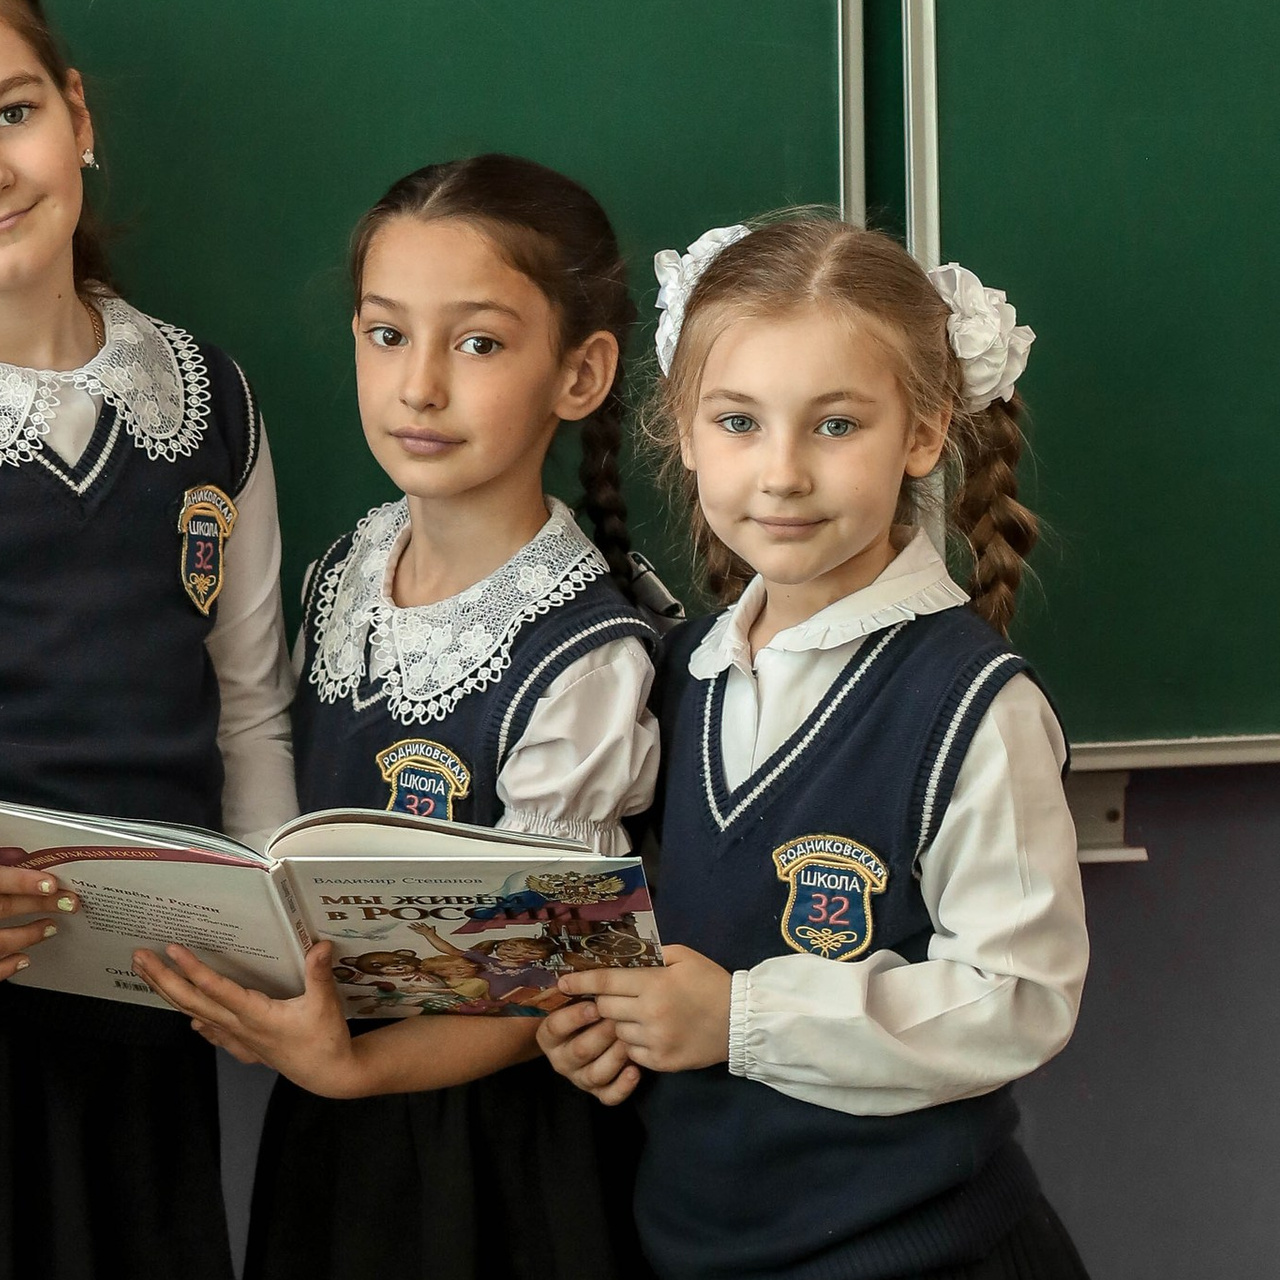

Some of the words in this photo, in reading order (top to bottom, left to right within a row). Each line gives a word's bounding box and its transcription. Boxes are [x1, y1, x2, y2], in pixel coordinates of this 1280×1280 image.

[189, 520, 219, 537] ШКОЛА
[195, 541, 214, 570] 32
[382, 743, 467, 783] РОДНИКОВСКАЯ
[400, 772, 446, 796] ШКОЛА
[109, 849, 159, 859] РОССИИ
[778, 840, 885, 878] РОДНИКОВСКАЯ
[313, 876, 396, 886] Владимир
[402, 876, 483, 885] Степанов
[800, 870, 862, 893] ШКОЛА
[319, 894, 384, 906] МЫ
[391, 892, 522, 906] ЖИВЁМ
[808, 893, 850, 926] 32
[361, 906, 583, 922] РОССИИ
